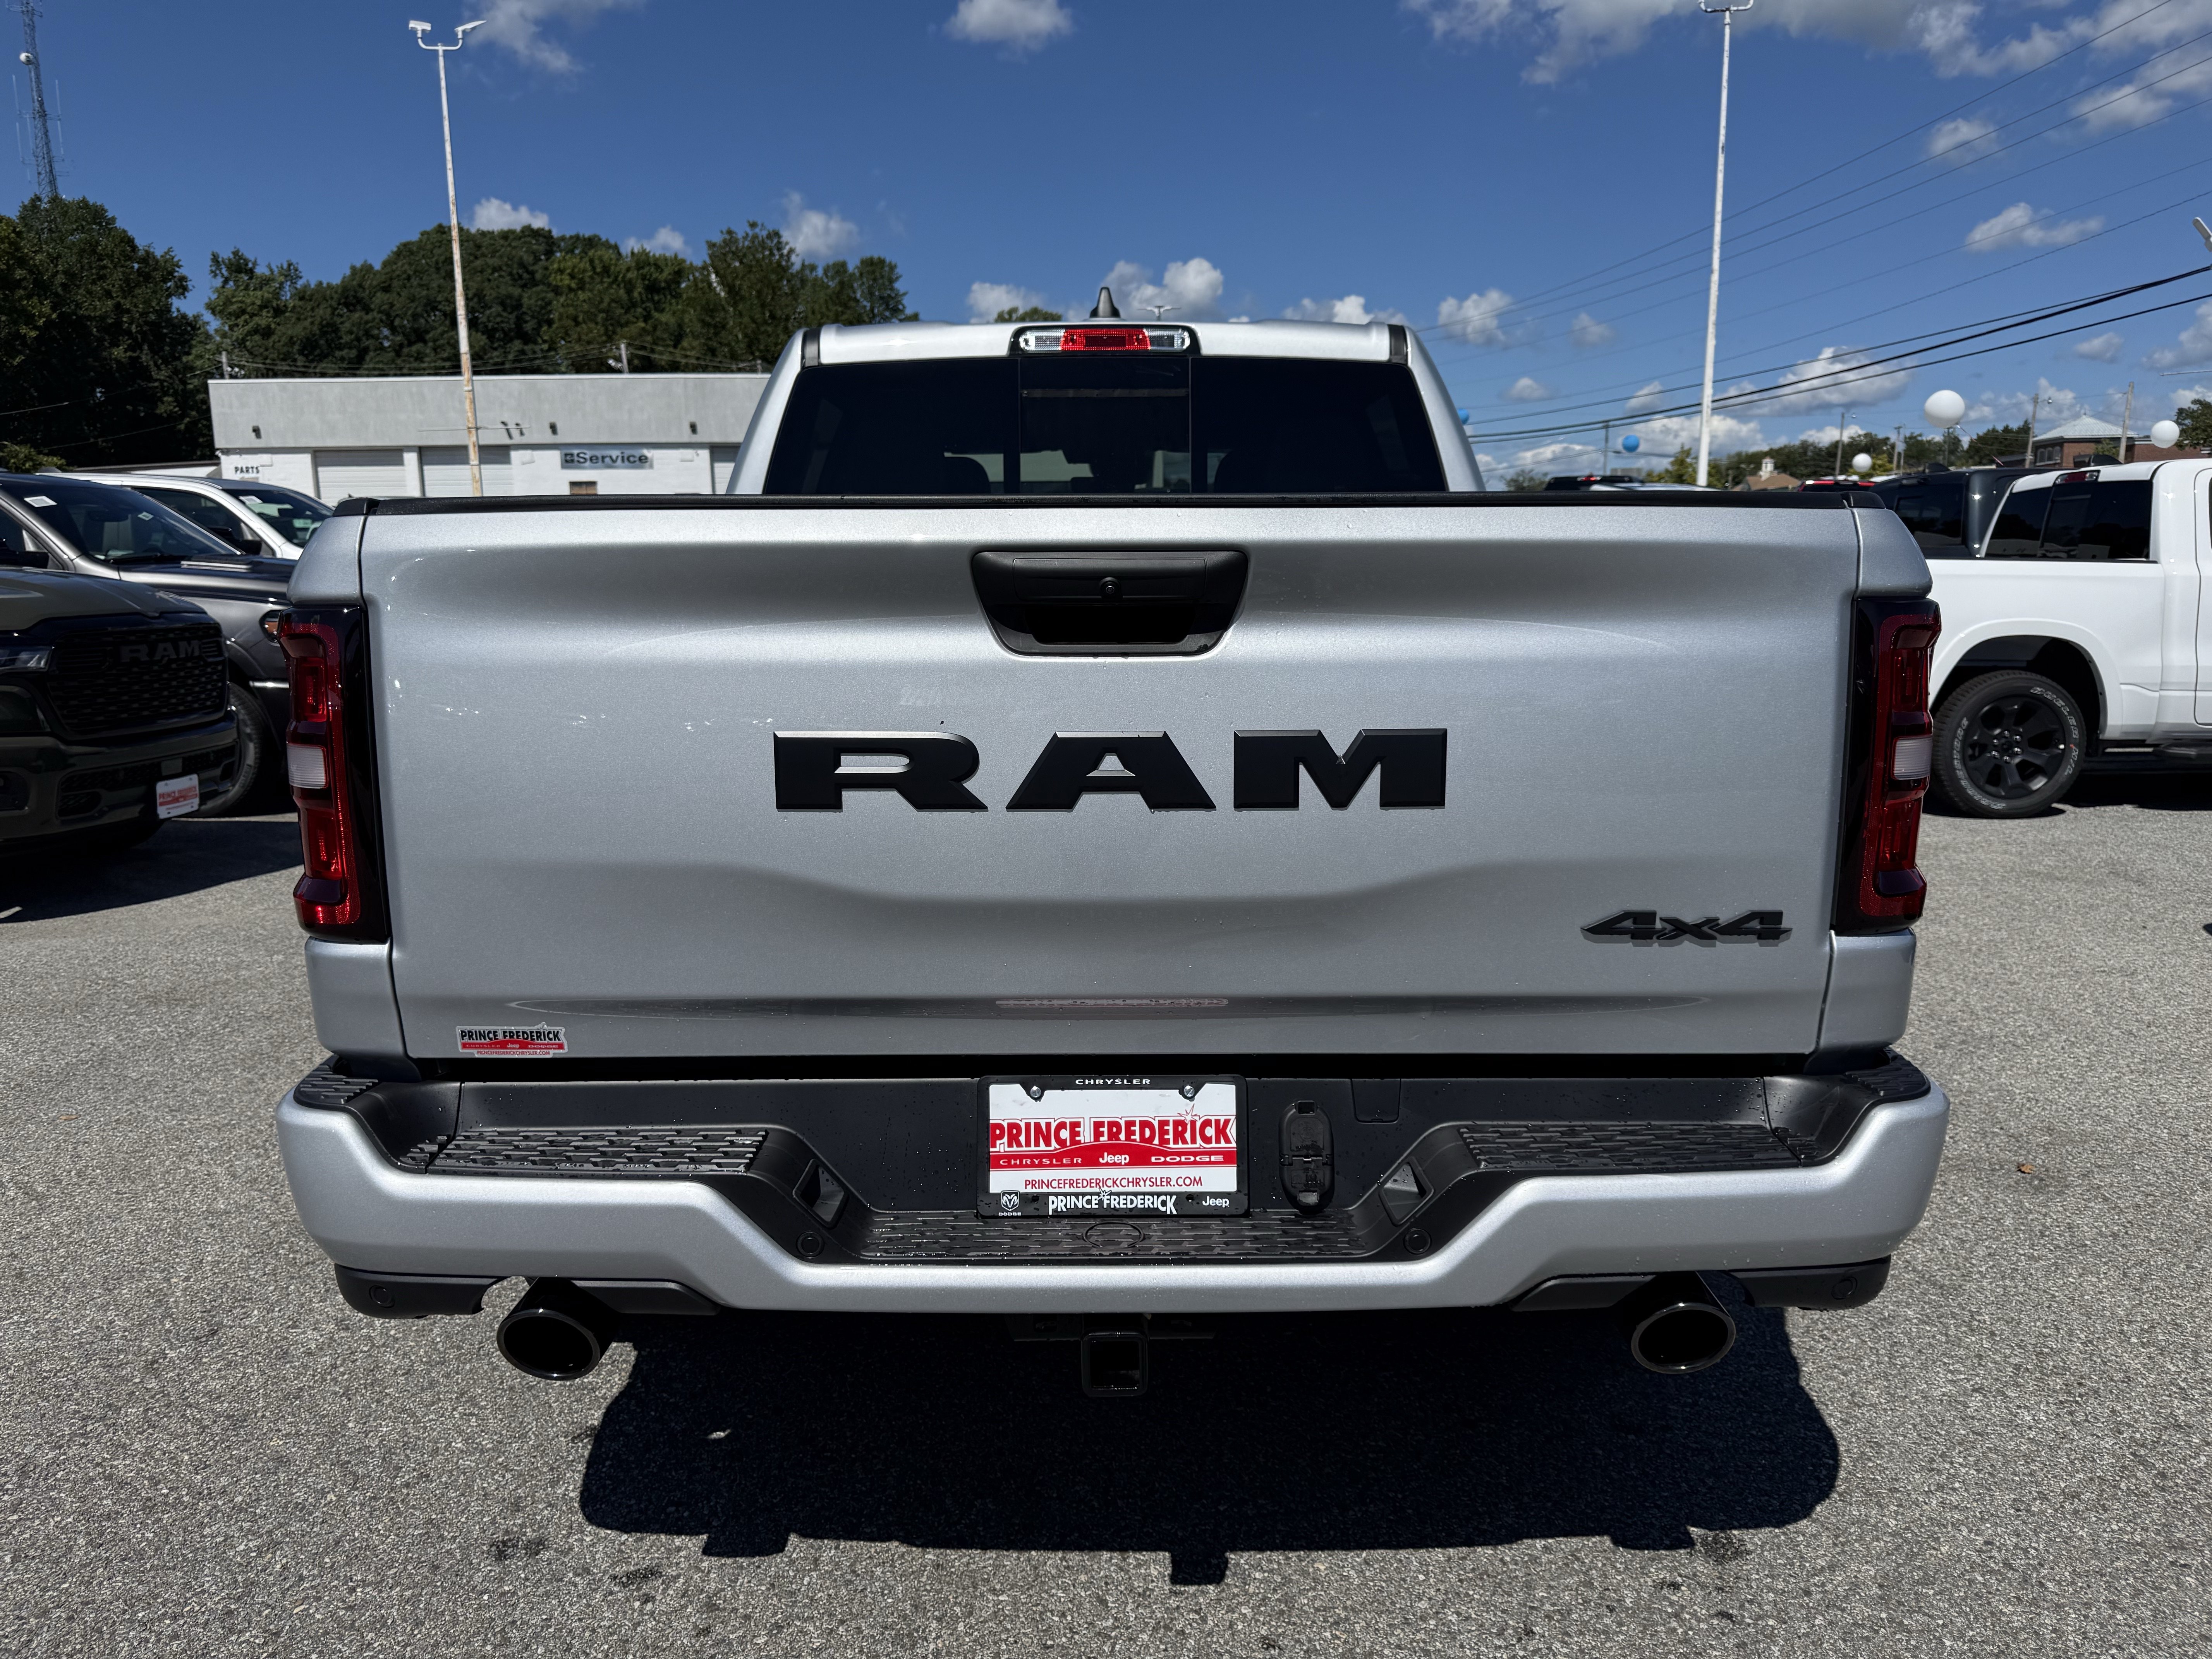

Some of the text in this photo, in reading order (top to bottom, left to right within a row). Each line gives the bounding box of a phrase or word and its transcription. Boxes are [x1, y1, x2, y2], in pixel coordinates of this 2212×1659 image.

[576, 452, 649, 464] Service
[120, 640, 199, 662] RAM
[773, 728, 1448, 811] RAM
[1580, 910, 1793, 940] 4x4
[460, 1030, 562, 1041] PRINCE FREDERICK
[990, 1118, 1233, 1149] PRINCE FREDERICK
[1099, 1152, 1129, 1165] Jeep
[1024, 1176, 1203, 1190] PRINCEFREDERICKCHRYSLER.COM
[1048, 1195, 1178, 1215] PRINCE FREDERICK
[1202, 1195, 1230, 1208] Jeep
